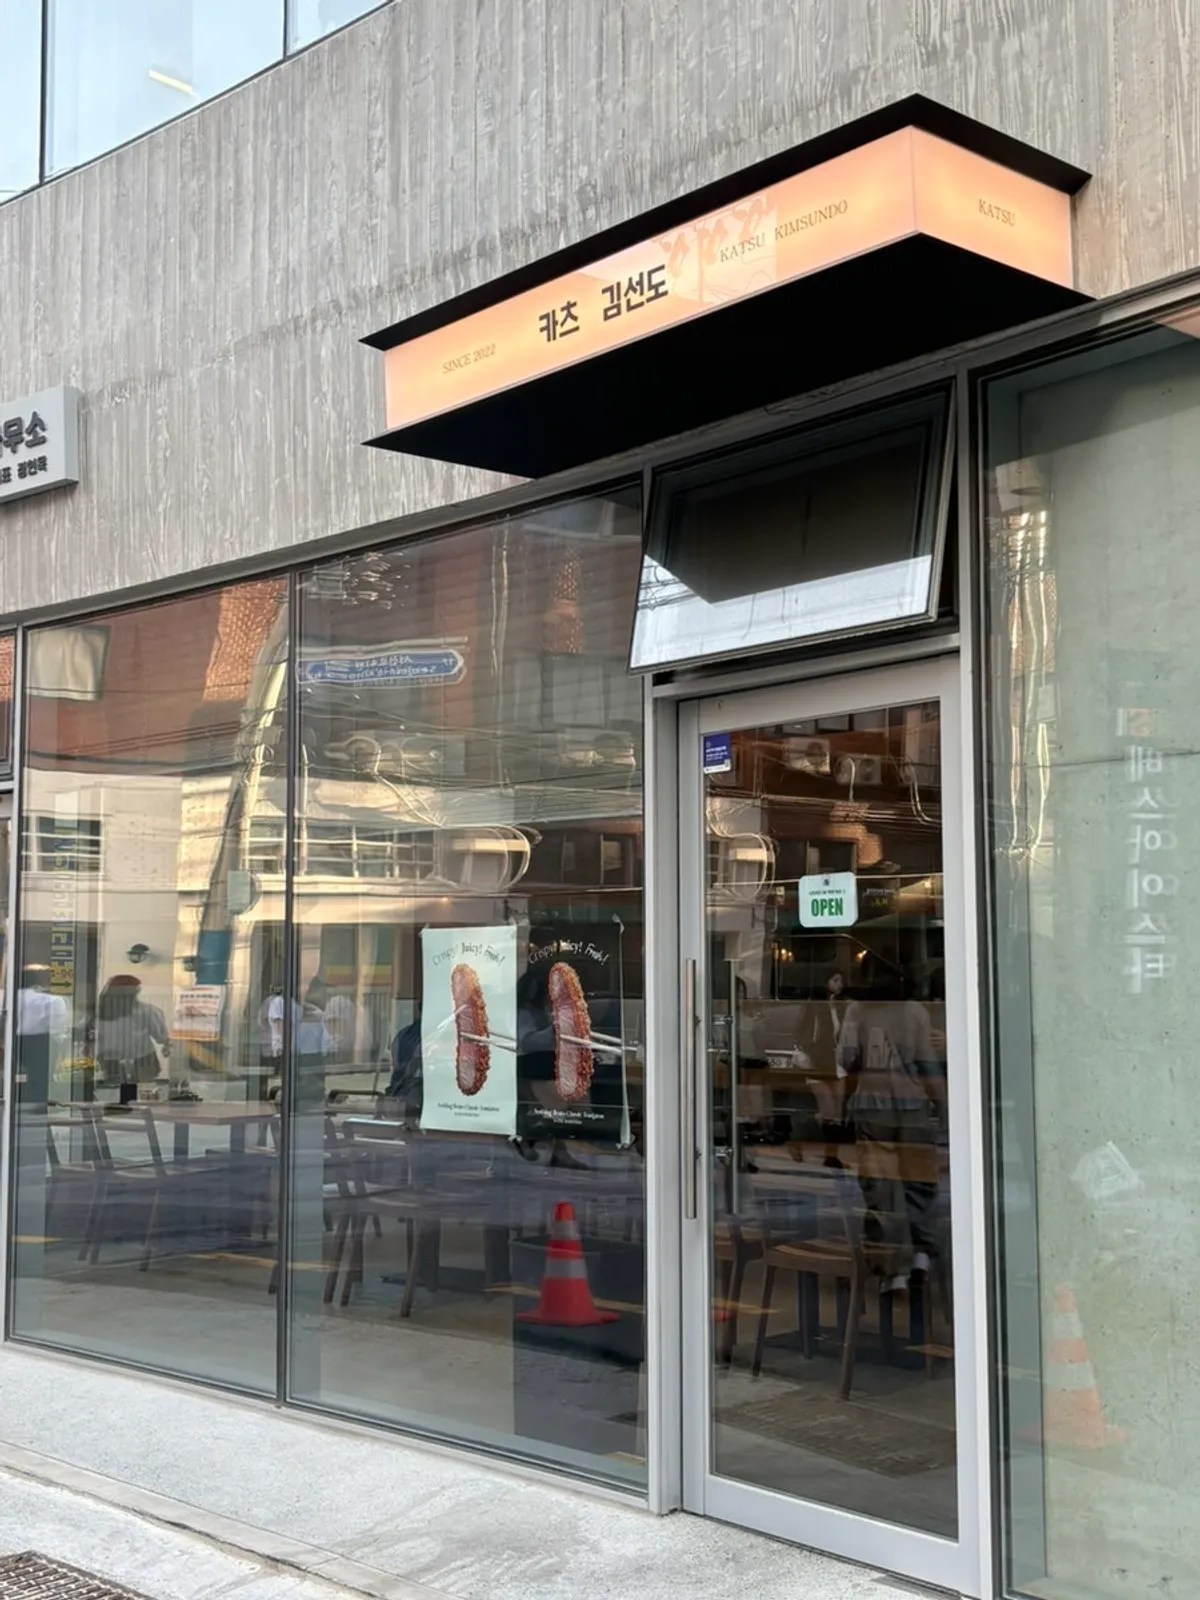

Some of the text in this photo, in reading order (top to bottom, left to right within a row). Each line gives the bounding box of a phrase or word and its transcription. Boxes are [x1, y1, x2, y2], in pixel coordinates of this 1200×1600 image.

[978, 198, 1015, 227] KATSU
[719, 199, 848, 263] KATSU KIMSUNDO
[538, 264, 669, 343] 카츠 김선도
[442, 342, 496, 374] SINCE 2022
[0, 410, 47, 460] 무소
[810, 897, 844, 917] OPEN
[461, 941, 483, 956] Juicy!
